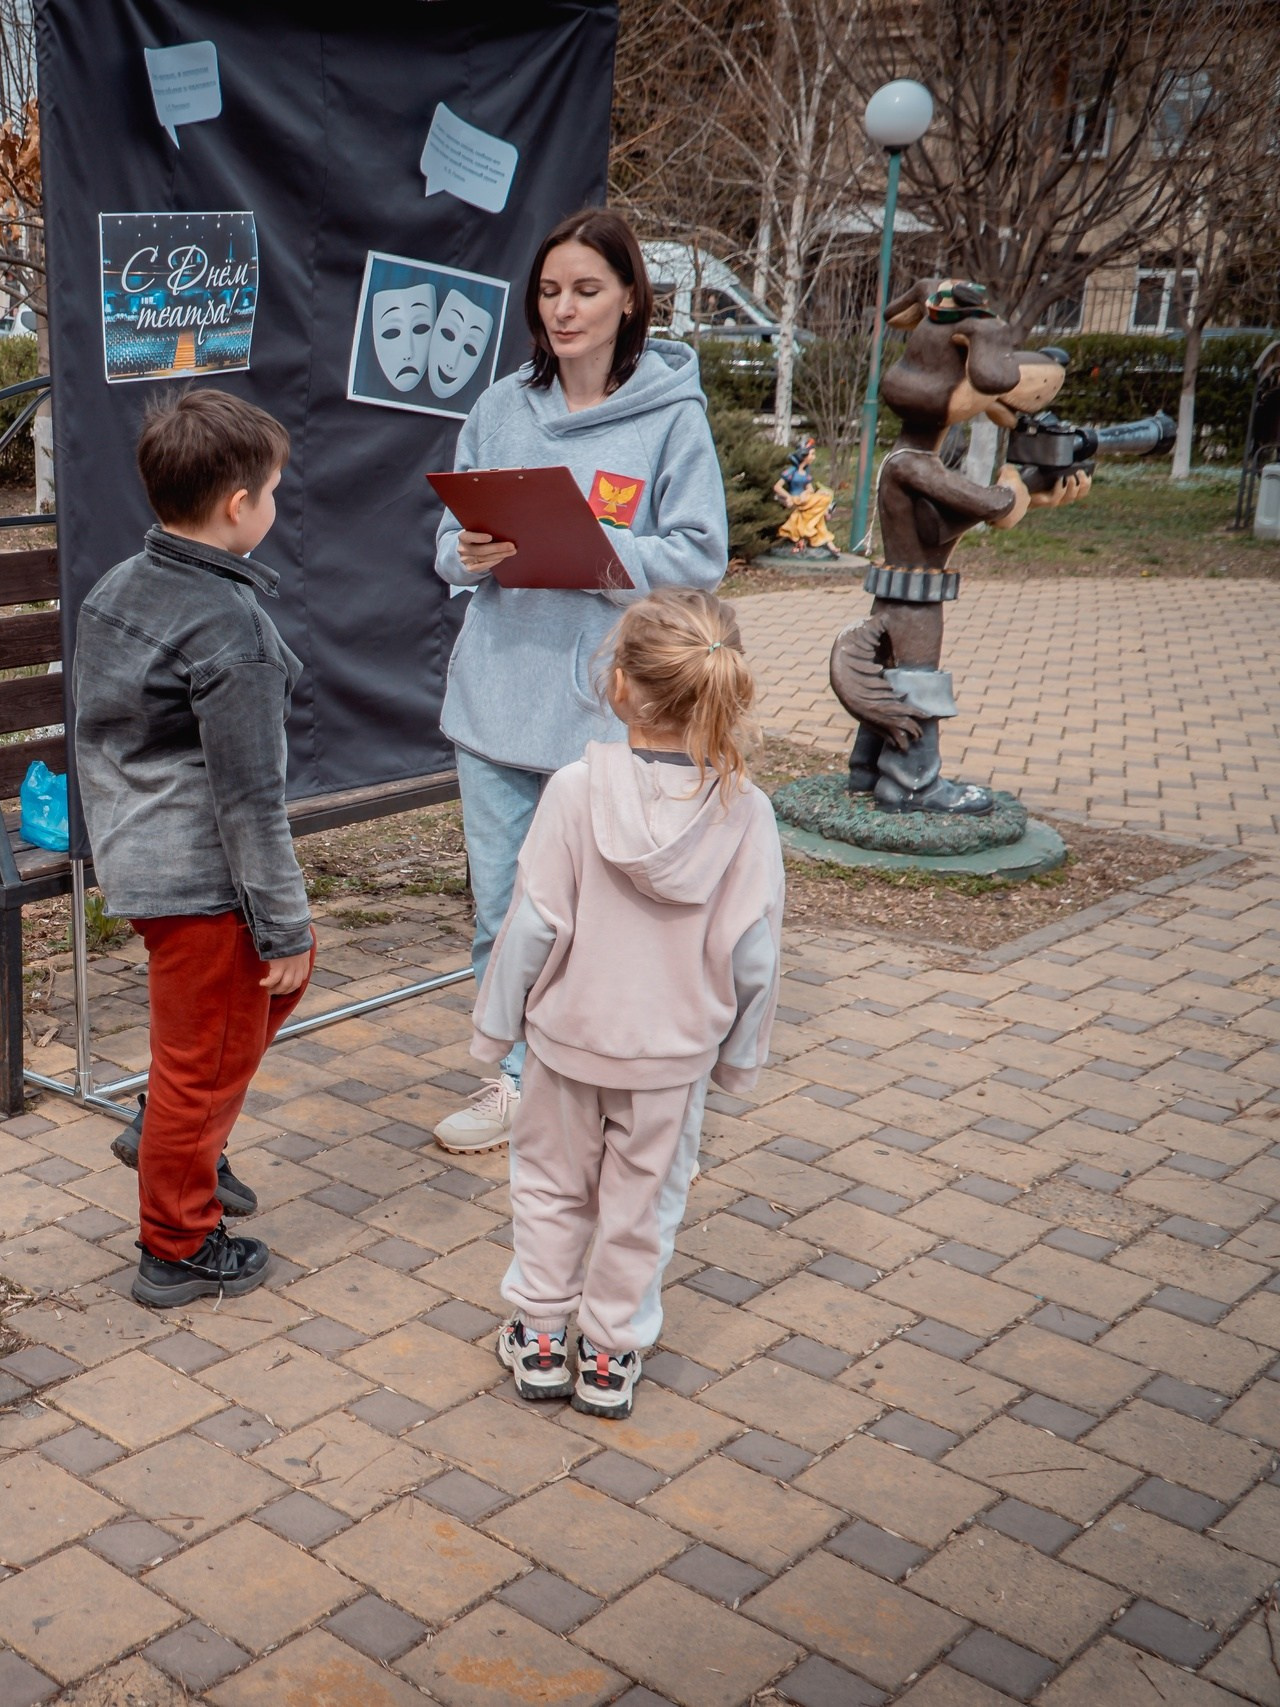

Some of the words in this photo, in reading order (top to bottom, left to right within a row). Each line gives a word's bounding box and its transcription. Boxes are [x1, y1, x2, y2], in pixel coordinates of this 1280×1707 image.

[121, 245, 160, 293] С
[166, 244, 249, 295] Днём
[136, 288, 240, 345] театра!
